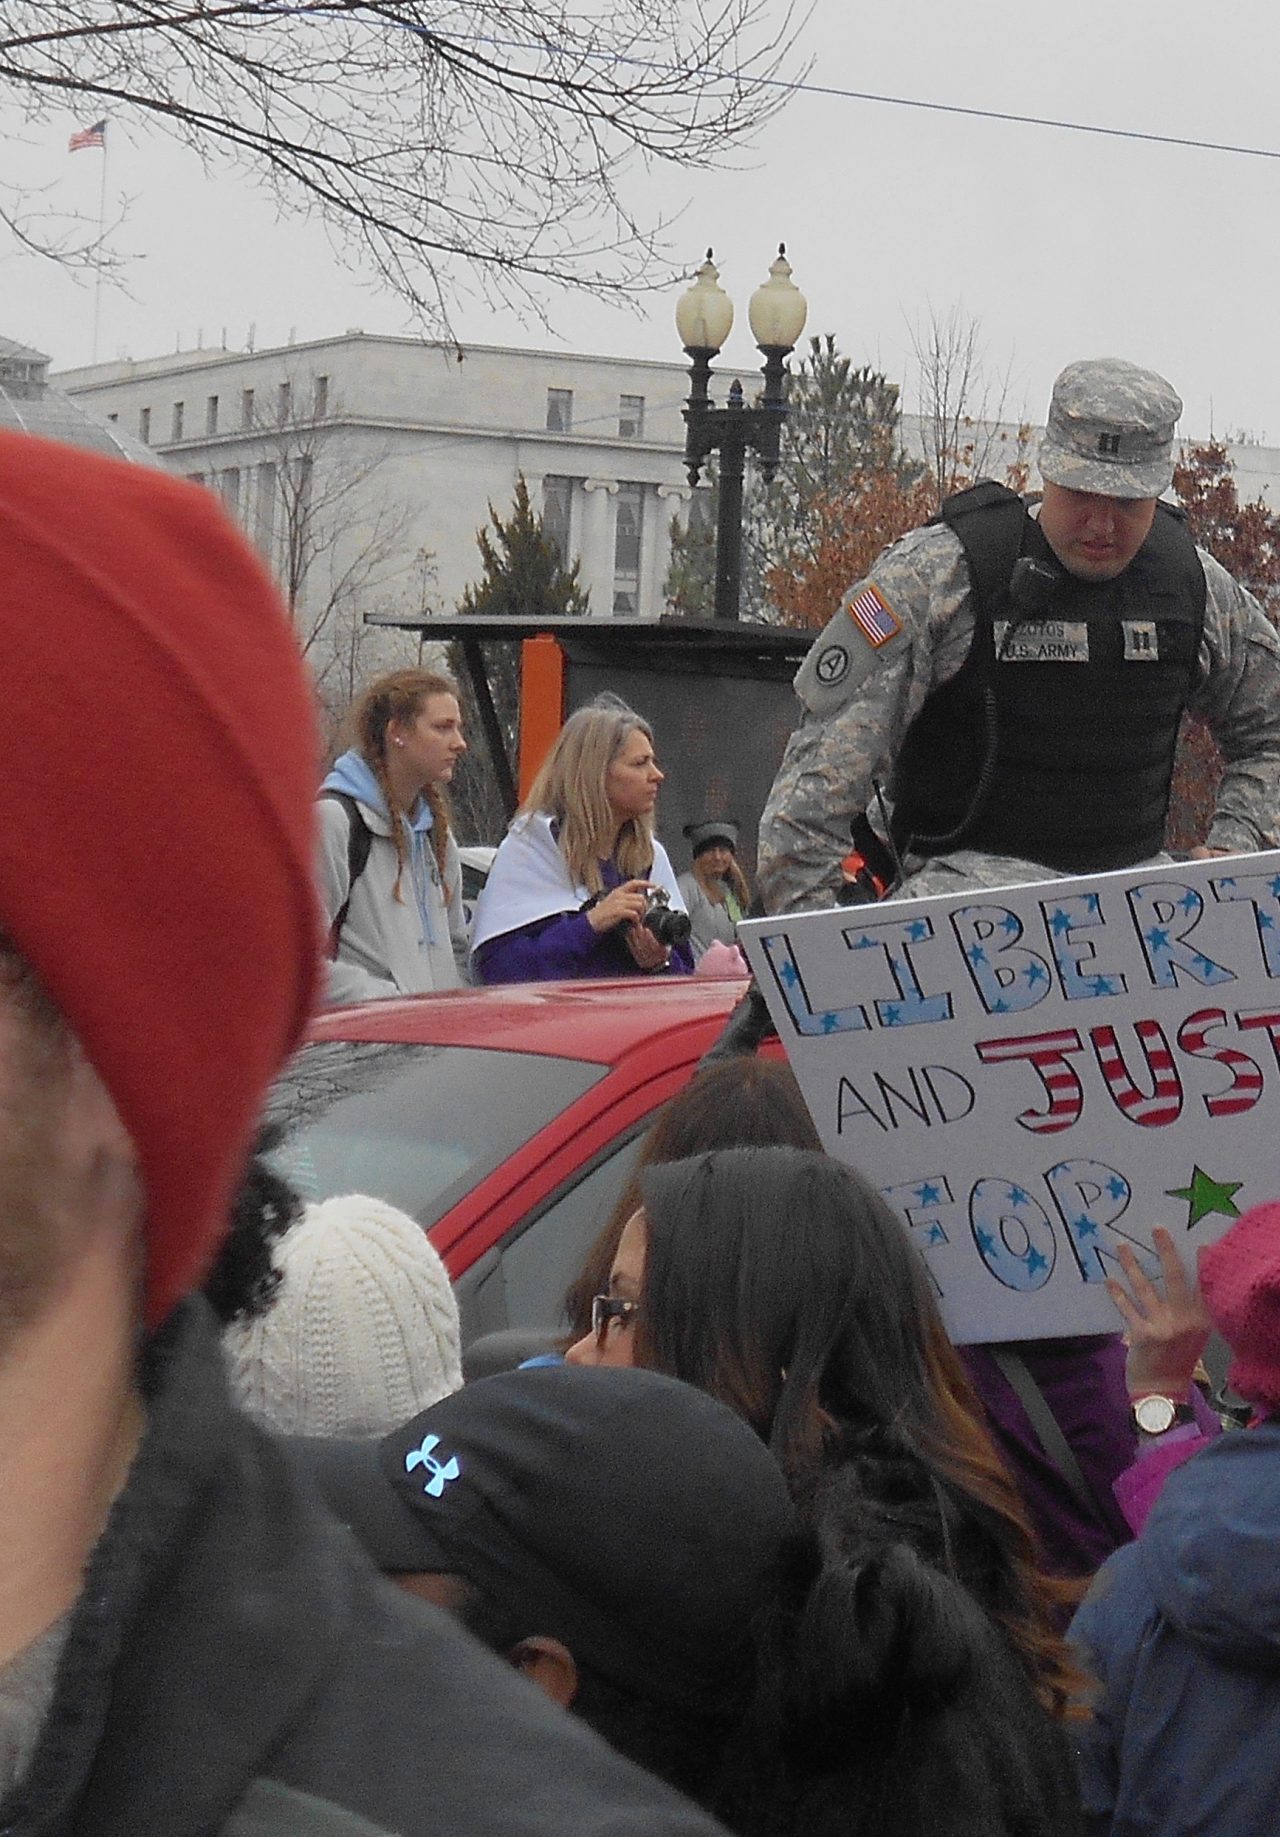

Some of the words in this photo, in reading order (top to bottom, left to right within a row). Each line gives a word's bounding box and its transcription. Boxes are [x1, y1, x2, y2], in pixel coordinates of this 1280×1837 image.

[1038, 642, 1077, 658] ARMY
[835, 1065, 976, 1135] AND
[882, 1158, 1164, 1297] FOR
